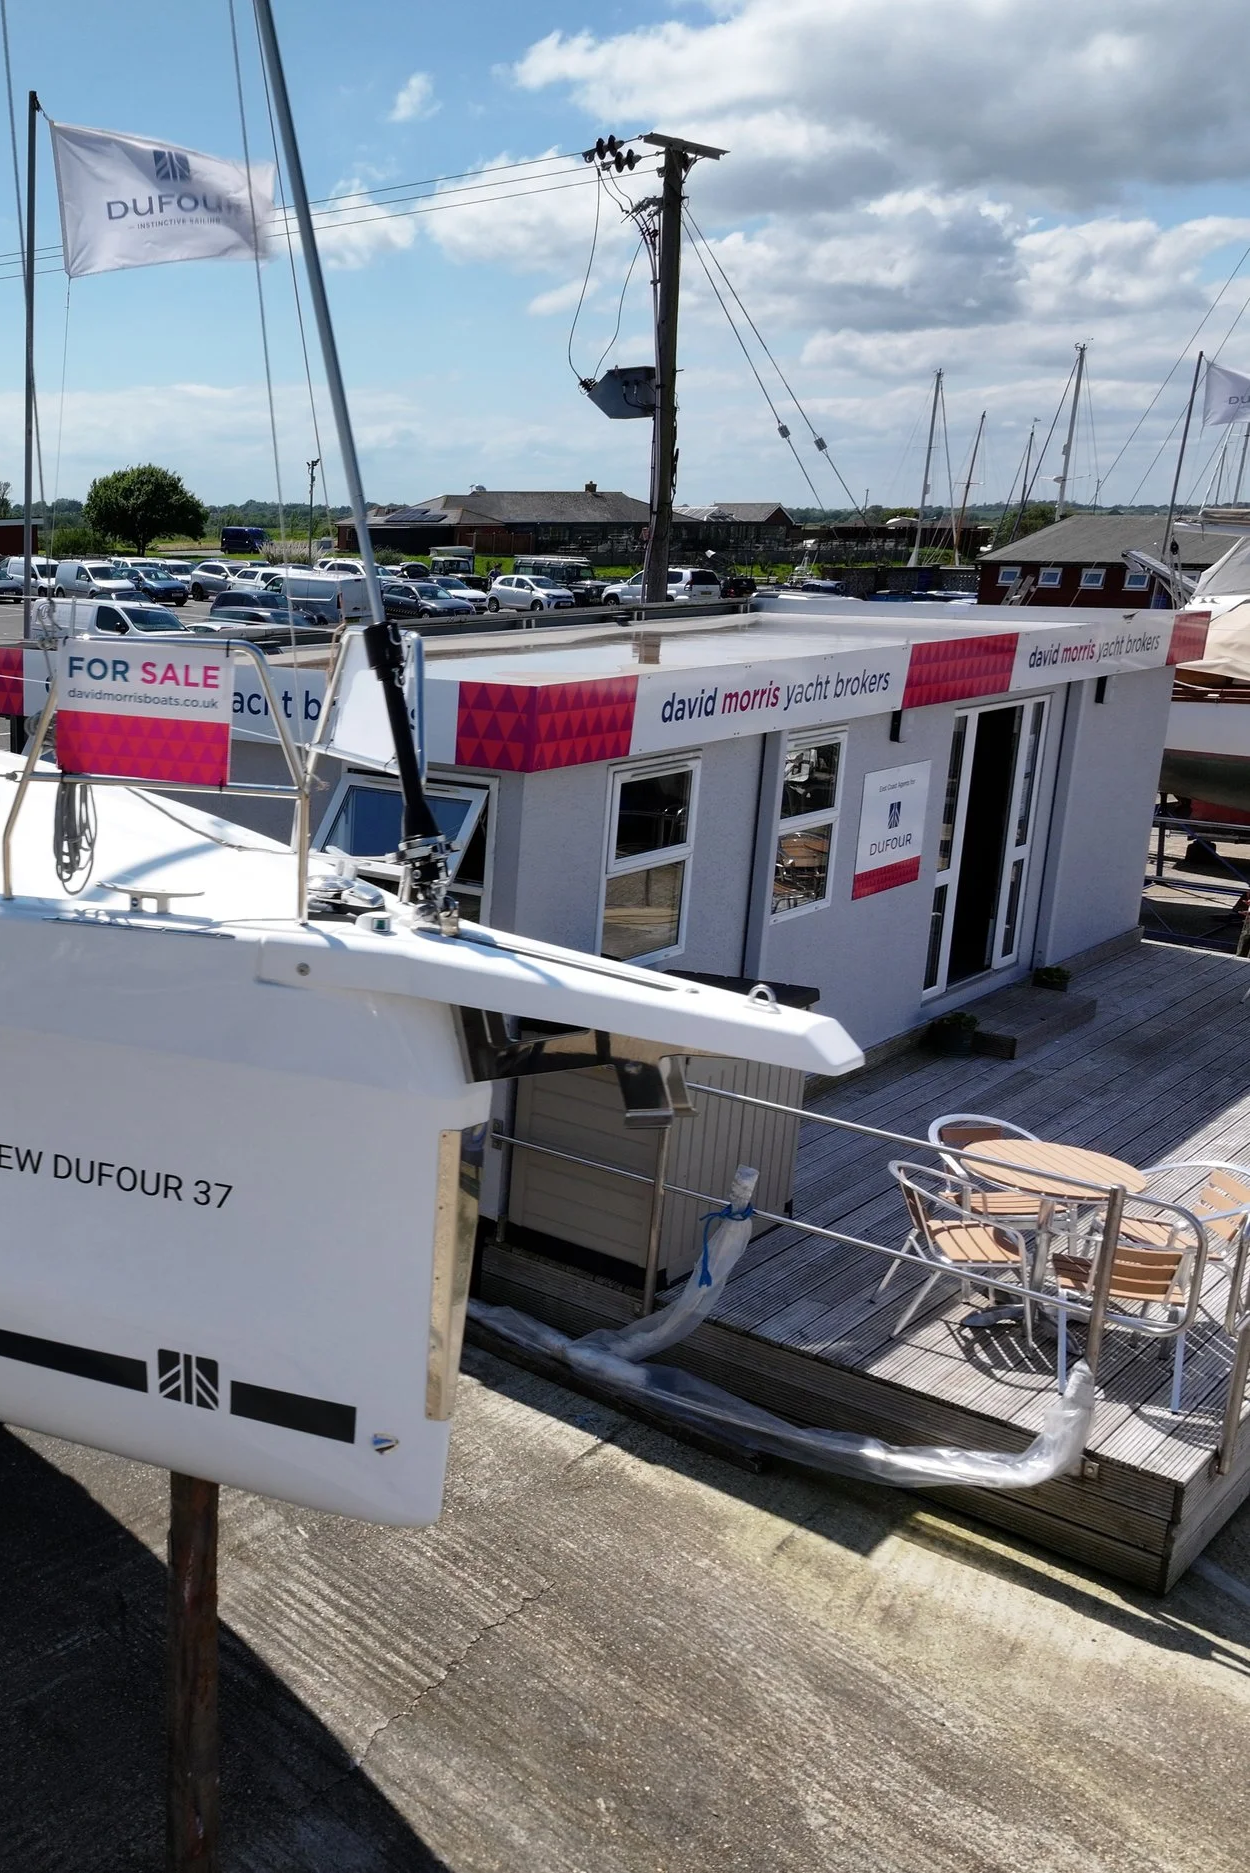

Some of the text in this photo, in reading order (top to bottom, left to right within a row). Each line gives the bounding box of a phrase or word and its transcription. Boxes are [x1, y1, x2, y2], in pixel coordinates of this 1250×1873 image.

[1028, 632, 1161, 668] david morris yacht brokers
[68, 656, 221, 689] FOR SALE
[67, 687, 219, 709] davidmorrisboats.co.uk
[661, 668, 891, 723] david morris yacht brokers
[869, 833, 912, 856] DUFOUR
[53, 1153, 183, 1201] DUFOUR
[193, 1179, 233, 1209] 37
